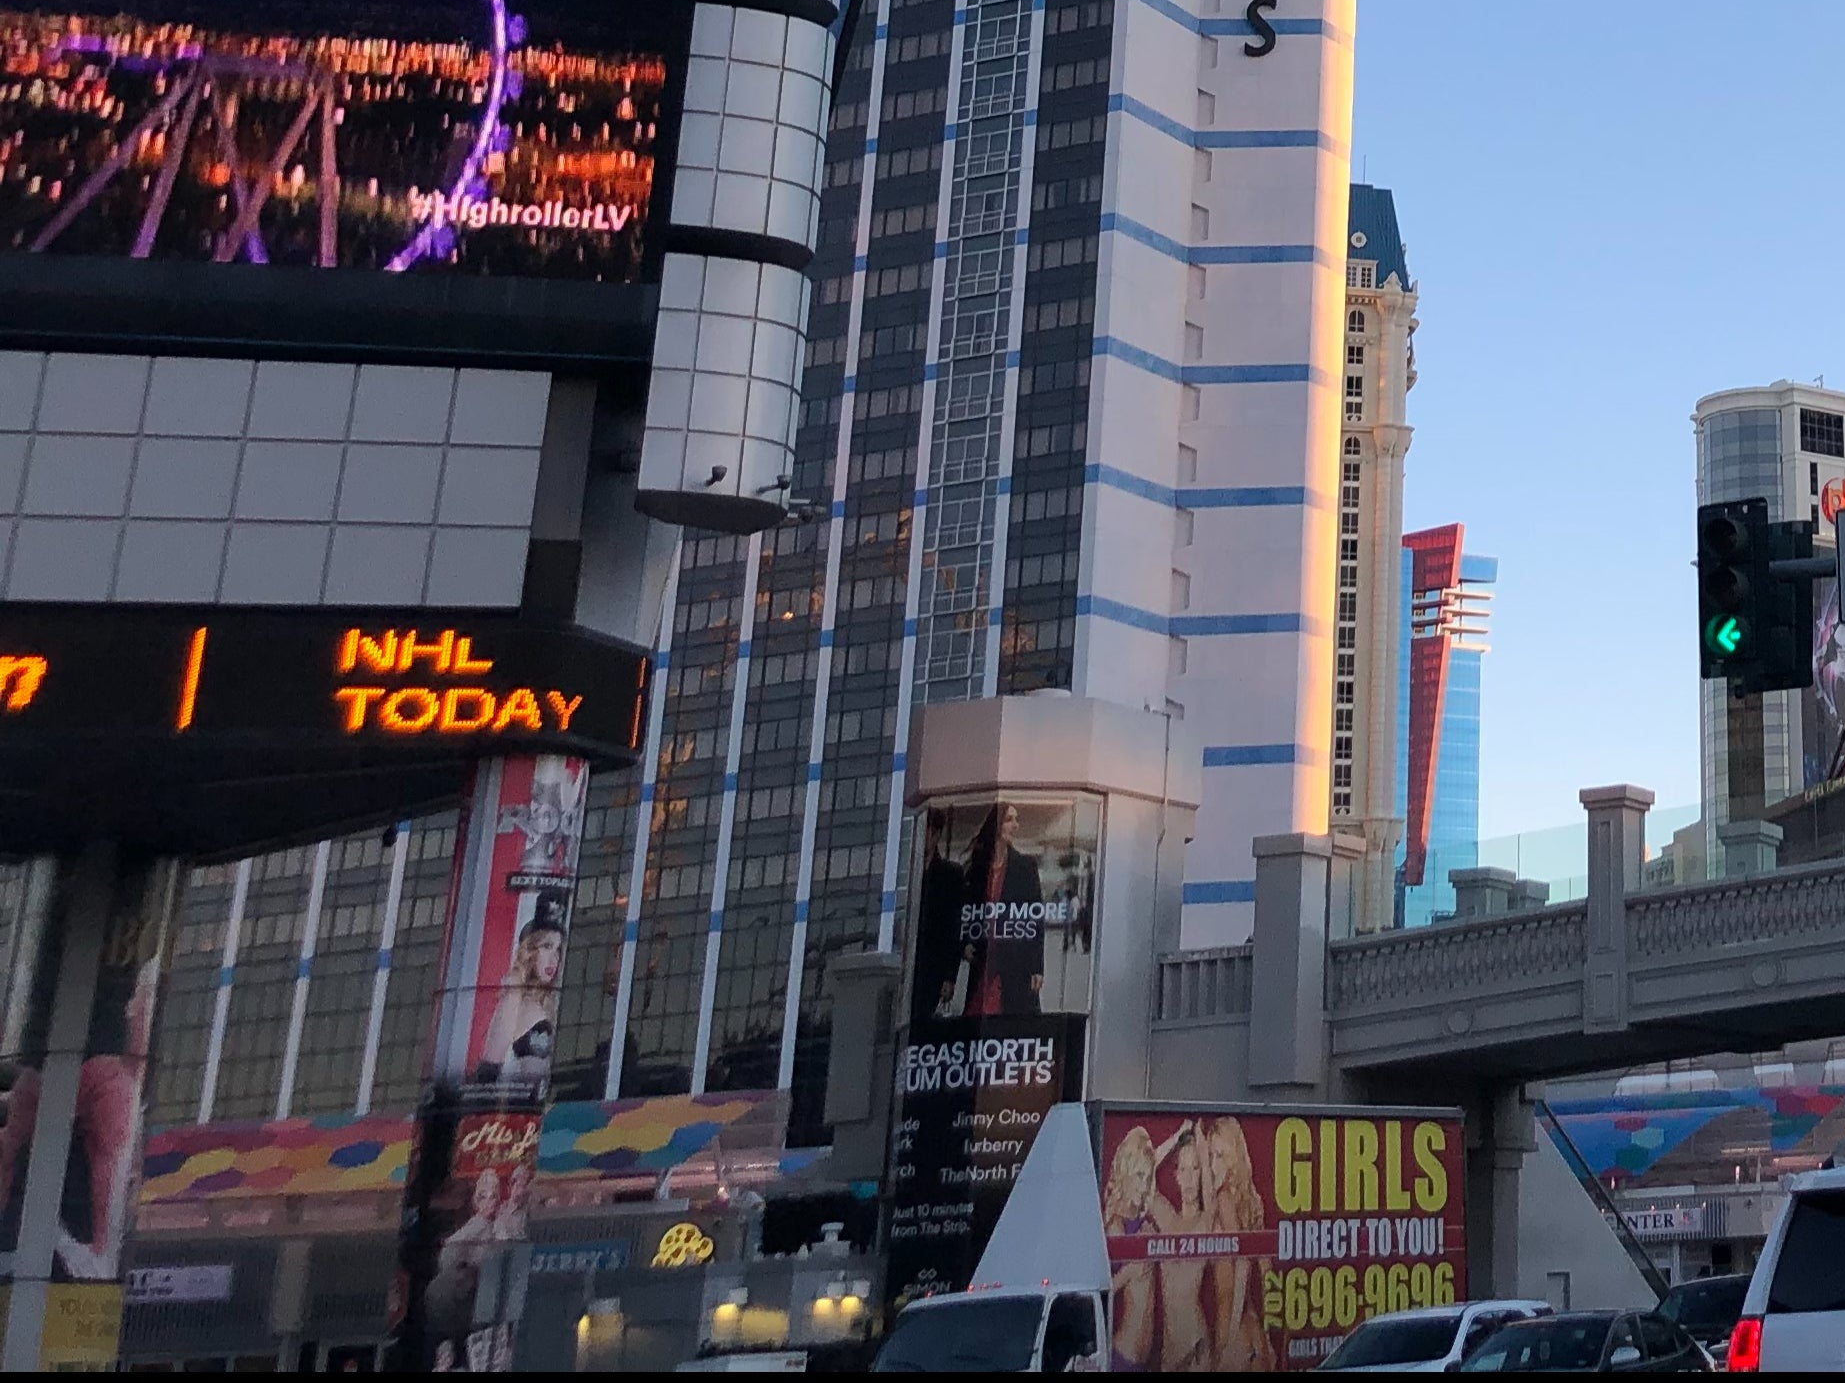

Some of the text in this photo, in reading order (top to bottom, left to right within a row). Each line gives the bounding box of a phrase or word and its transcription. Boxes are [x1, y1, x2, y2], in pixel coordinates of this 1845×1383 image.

[336, 627, 495, 673] NHL
[334, 686, 584, 732] TODAY
[961, 902, 1066, 922] SHOP MORE
[960, 920, 1037, 940] FOR LESS
[969, 1037, 1054, 1063] NORTH
[945, 1060, 1052, 1089] OUTLETS
[999, 1108, 1041, 1125] Choo
[940, 1167, 967, 1185] The
[967, 1164, 1007, 1181] North
[1274, 1115, 1448, 1214] GIRLS
[918, 1202, 930, 1217] 10
[1147, 1236, 1240, 1256] CALL 24 HOURS
[1278, 1217, 1445, 1261] DIRECT TO YOU!
[903, 1280, 953, 1295] SIMON
